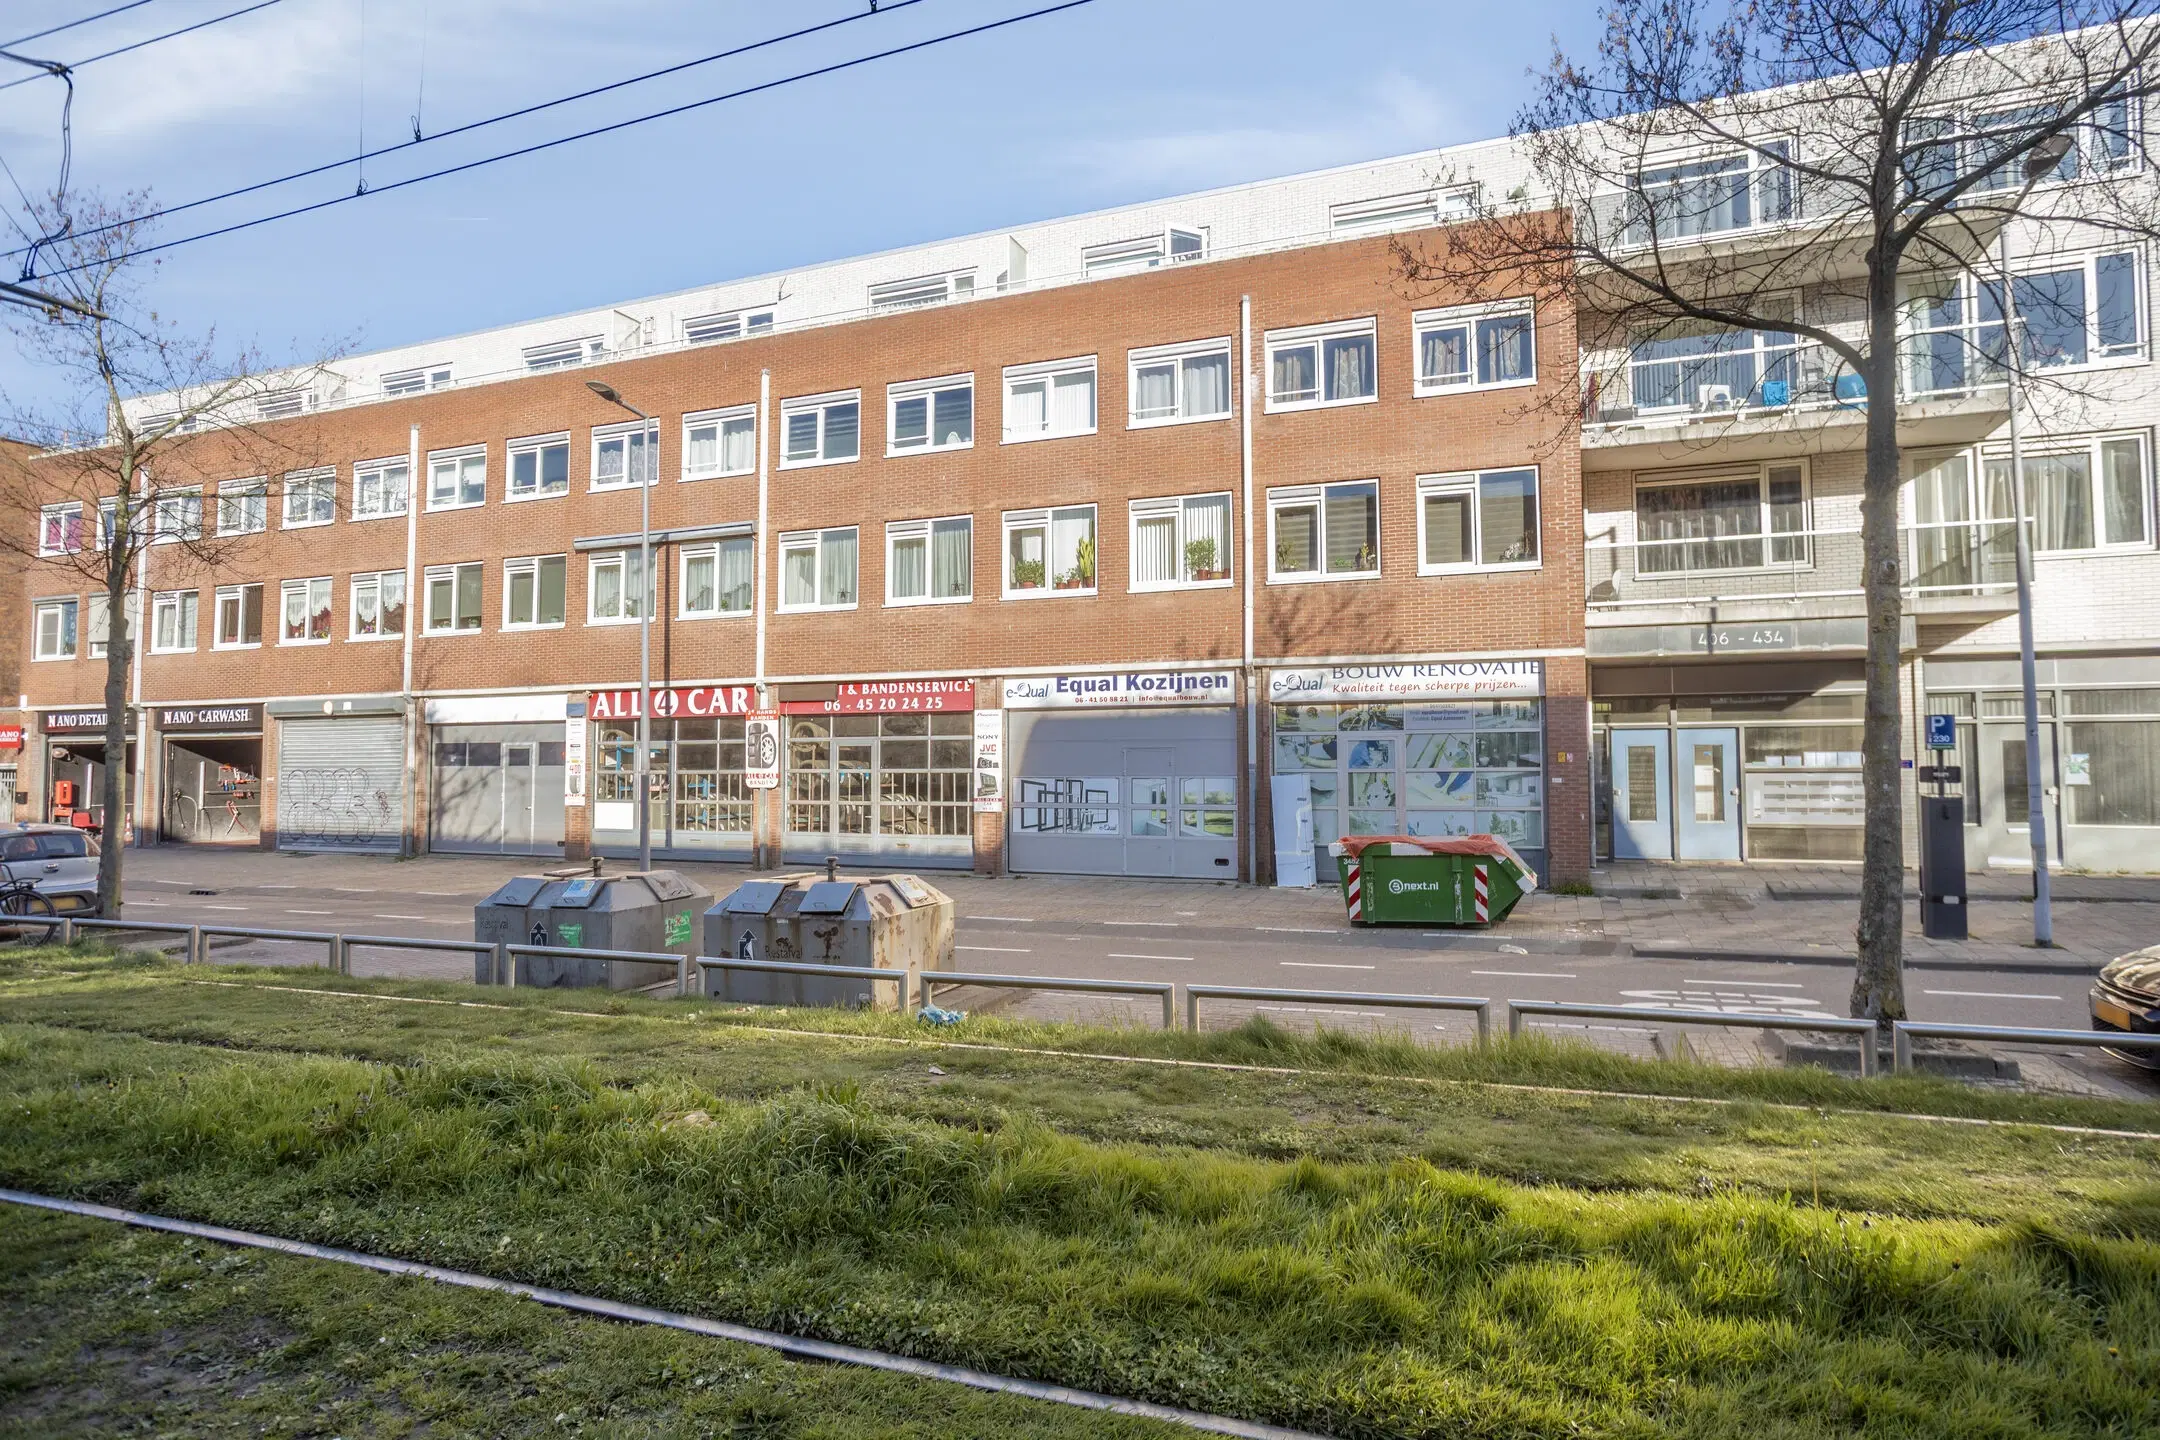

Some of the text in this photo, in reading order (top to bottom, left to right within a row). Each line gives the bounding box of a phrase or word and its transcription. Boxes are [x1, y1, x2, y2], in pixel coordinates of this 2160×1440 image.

[1752, 630, 1784, 644] 434
[1332, 661, 1541, 679] BOUW RENOVATIE
[847, 684, 857, 695] &
[862, 681, 971, 695] BANDENSERVICE
[1056, 672, 1229, 696] Equal Kozijnen
[1332, 682, 1384, 693] Kwaliteit
[1389, 682, 1421, 694] tegen
[1425, 680, 1469, 693] scherpe
[592, 692, 641, 718] ALL
[687, 687, 748, 715] CAR
[824, 701, 840, 712] 06
[856, 698, 873, 711] 45
[879, 698, 896, 710] 20
[902, 697, 919, 710] 24
[925, 696, 943, 708] 25
[48, 715, 76, 728] NANO
[198, 708, 248, 722] CARWASH
[1930, 716, 1946, 732] P
[980, 744, 996, 752] JVC
